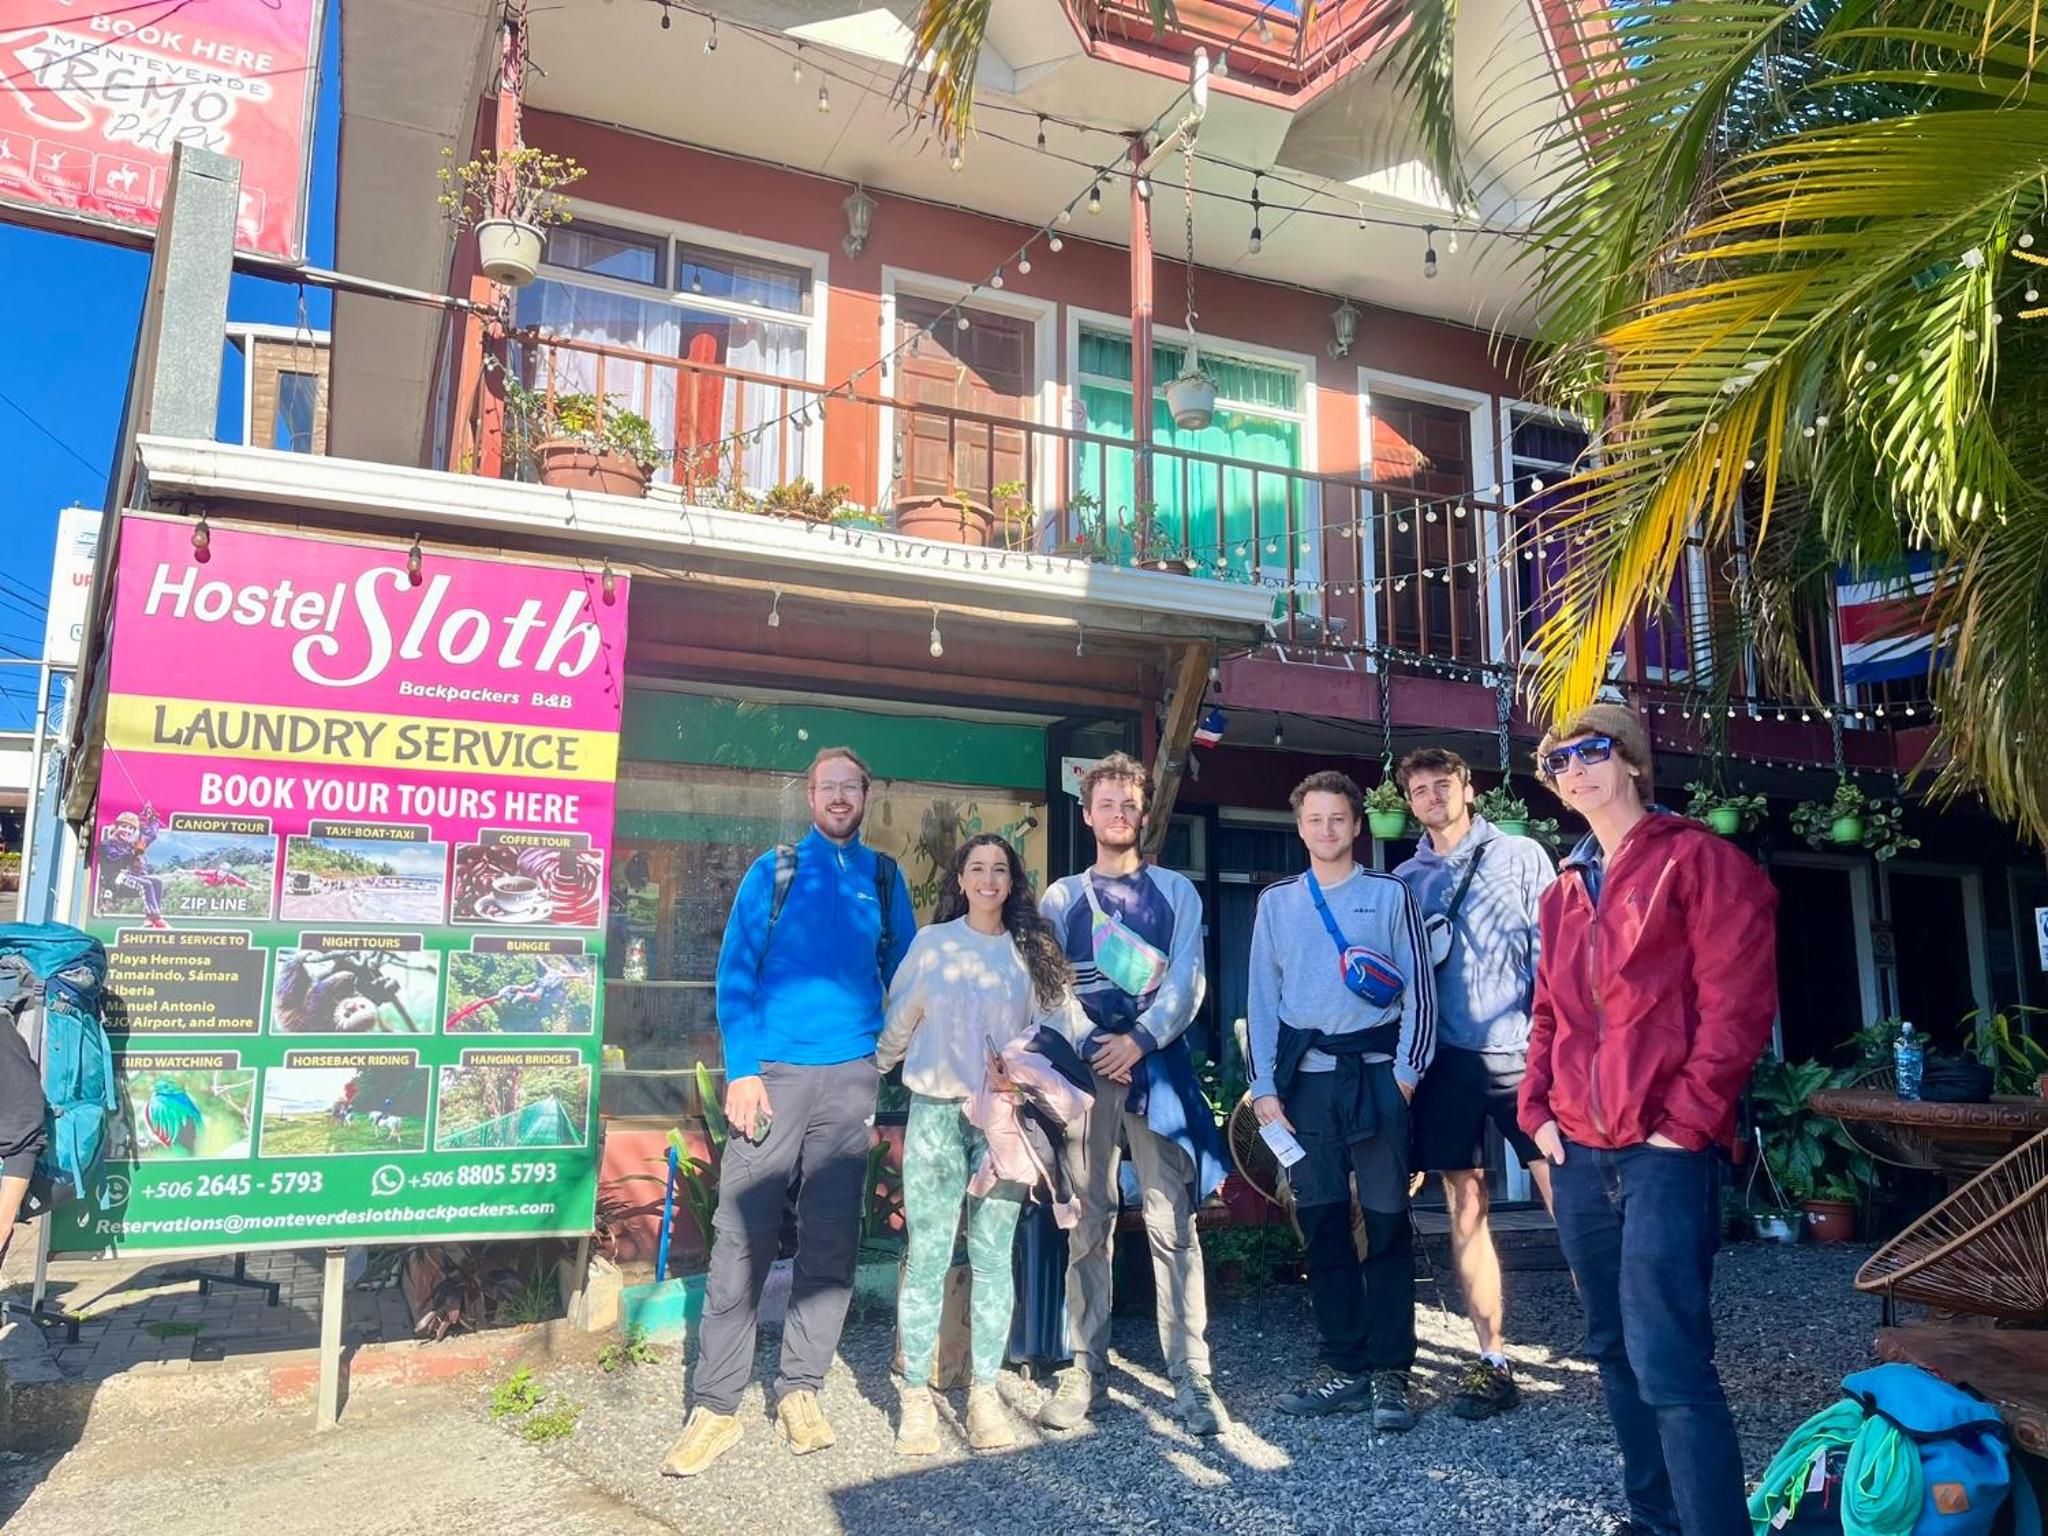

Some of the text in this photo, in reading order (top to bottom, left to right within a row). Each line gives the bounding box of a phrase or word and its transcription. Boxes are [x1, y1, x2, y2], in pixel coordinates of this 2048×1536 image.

[89, 13, 274, 71] BOOK HERE
[54, 35, 265, 96] MONTEVERDE
[144, 561, 601, 687] Hostel Sloth
[399, 680, 573, 709] Backpackers B&B
[153, 704, 580, 771] LAUNDRY SERVICE
[199, 772, 580, 824] BOOK YOUR TOURS HERE
[174, 818, 265, 833] CANOPY TOUR
[324, 825, 416, 839] TAXI-BOAT-TAXI
[499, 834, 571, 848] COFFEE TOUR
[179, 896, 248, 911] ZIP LINE
[122, 933, 245, 946] SHUTTLE SERVICE TO
[321, 936, 401, 949] NIGHT TOURS
[506, 940, 552, 951] BUNGEE
[110, 953, 212, 967] Playa Hermosa
[108, 969, 239, 983] Tamarindo, Sámara
[105, 1000, 216, 1012] Manuel Antonio
[132, 1015, 186, 1029] Airport,
[189, 1016, 216, 1027] and
[218, 1017, 254, 1027] more
[122, 1056, 224, 1068] BIRD WATCHING
[293, 1054, 409, 1067] HORSEBACK RIDING
[470, 1053, 573, 1066] HANGING BRIDGES
[408, 1162, 558, 1188] +506 8805 5793
[142, 1181, 193, 1199] +506
[195, 1174, 252, 1197] 2645
[269, 1171, 323, 1194] 5793
[95, 1201, 556, 1235] Reservations@monteverdeslothbackpackers.com
